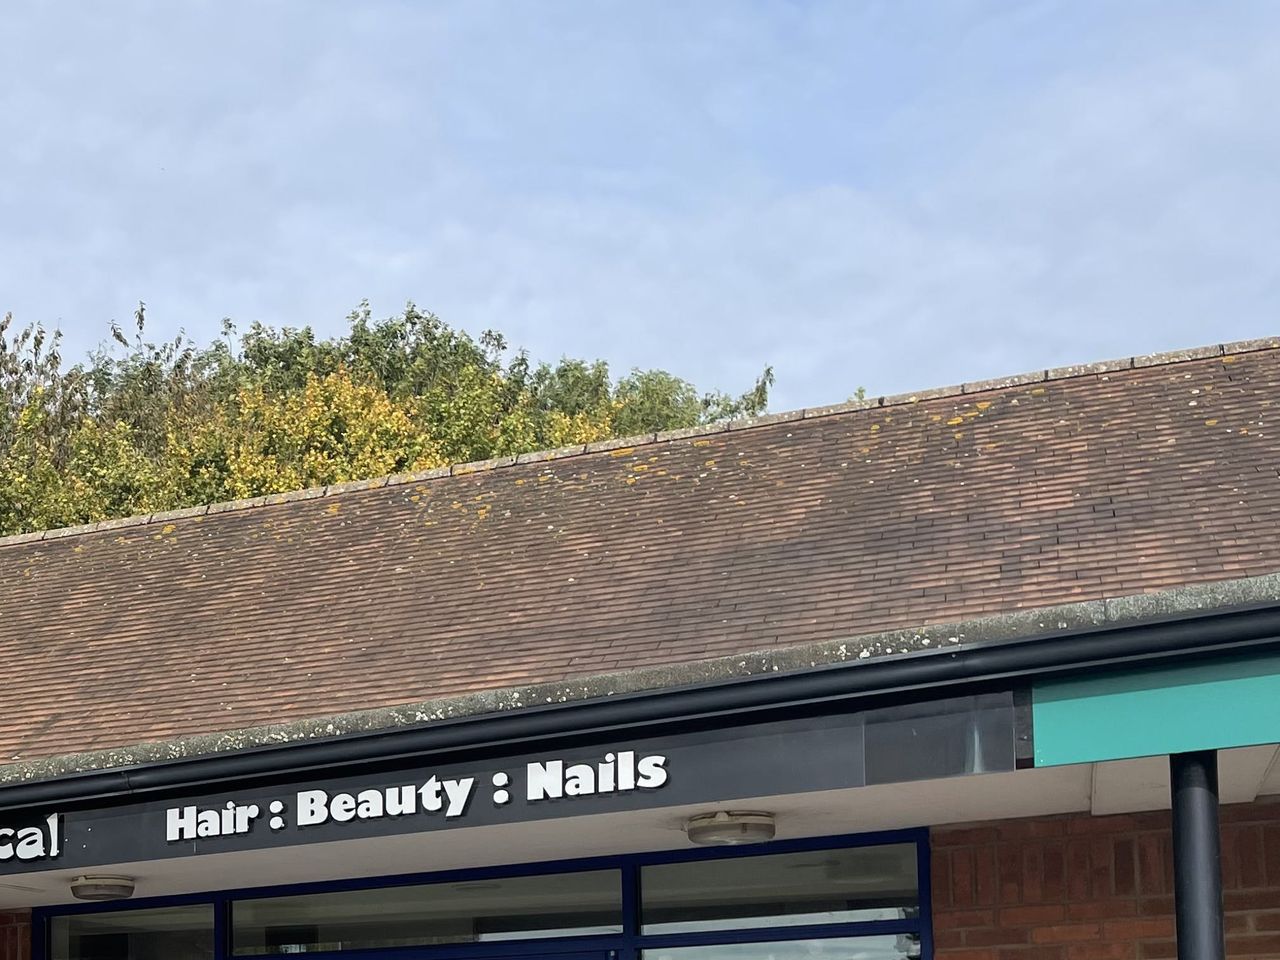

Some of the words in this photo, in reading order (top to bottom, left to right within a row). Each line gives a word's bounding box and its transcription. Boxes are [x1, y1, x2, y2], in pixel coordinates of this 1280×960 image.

[166, 801, 259, 841] Hair
[296, 774, 475, 826] Beauty
[526, 750, 668, 801] Nails
